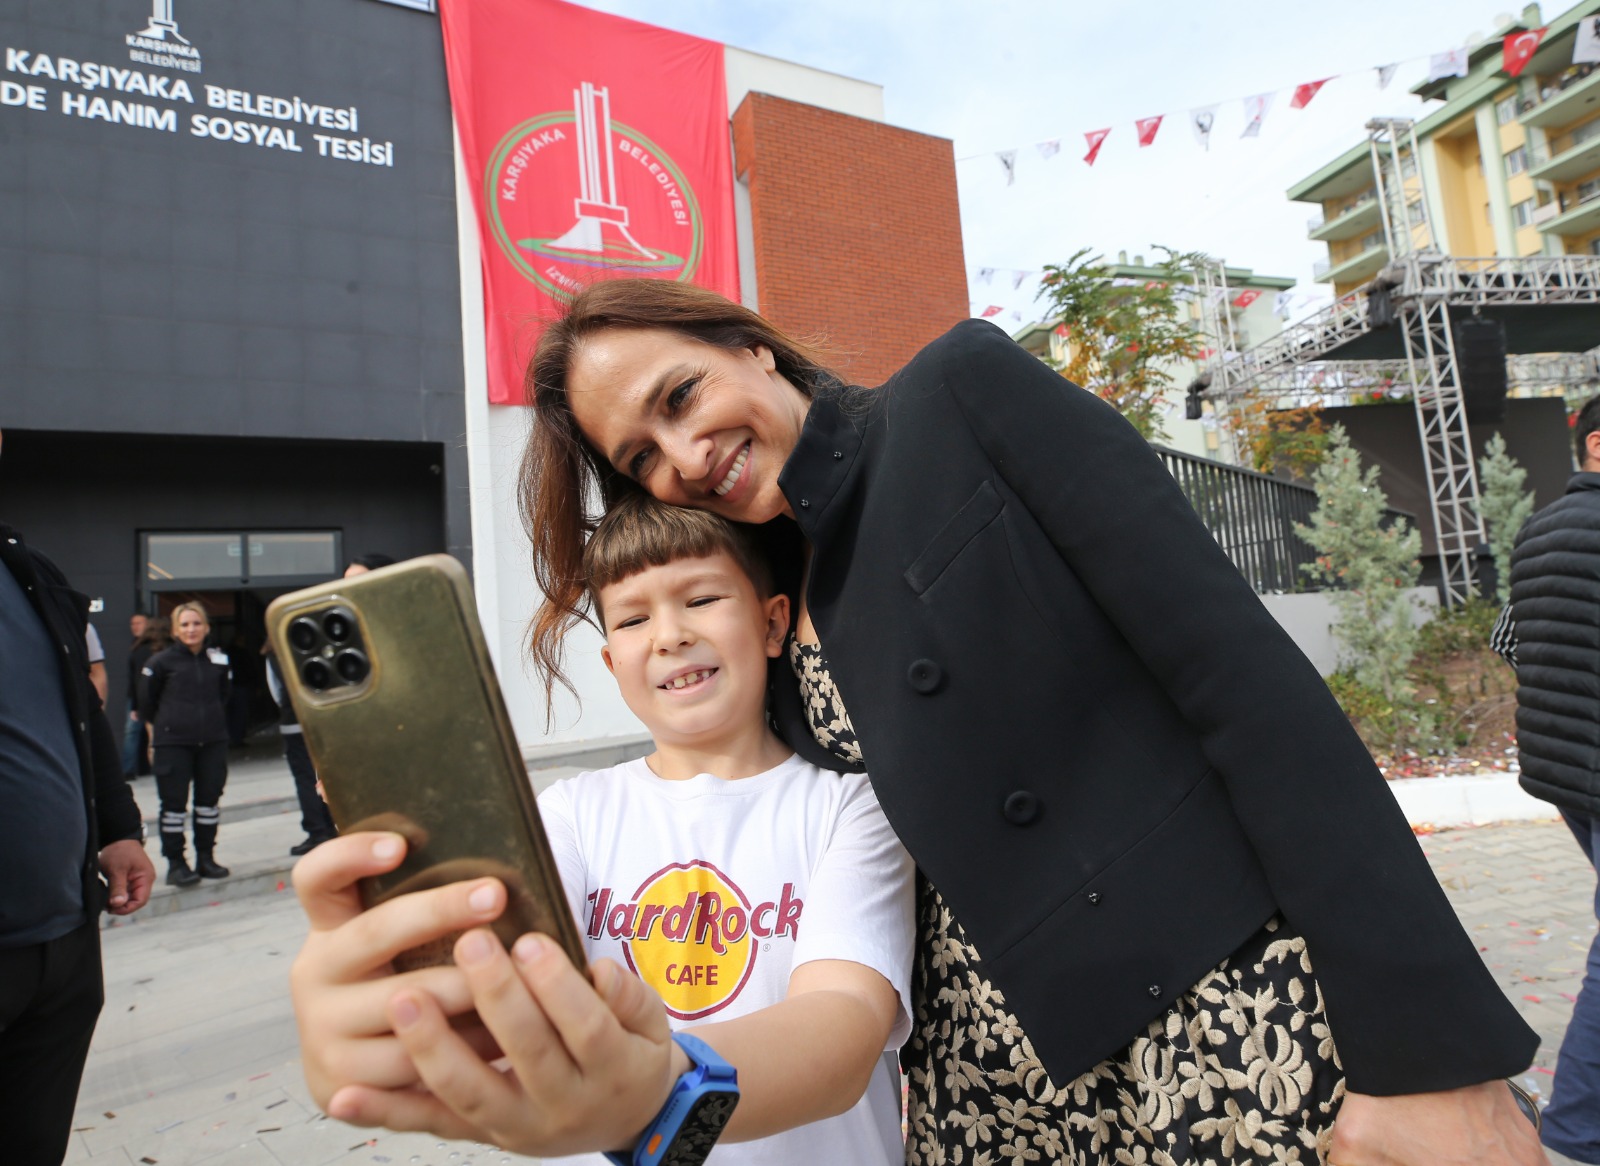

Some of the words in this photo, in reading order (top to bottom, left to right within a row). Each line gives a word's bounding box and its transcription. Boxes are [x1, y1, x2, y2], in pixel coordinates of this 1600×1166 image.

[5, 47, 194, 103] KARŞIYAKA
[204, 83, 358, 133] BELEDİYESİ
[61, 91, 177, 133] HANIM
[190, 114, 302, 153] SOSYAL
[313, 134, 394, 167] TESİSİ
[502, 128, 567, 202] KARŞIYAKA
[665, 963, 719, 986] CAFE
